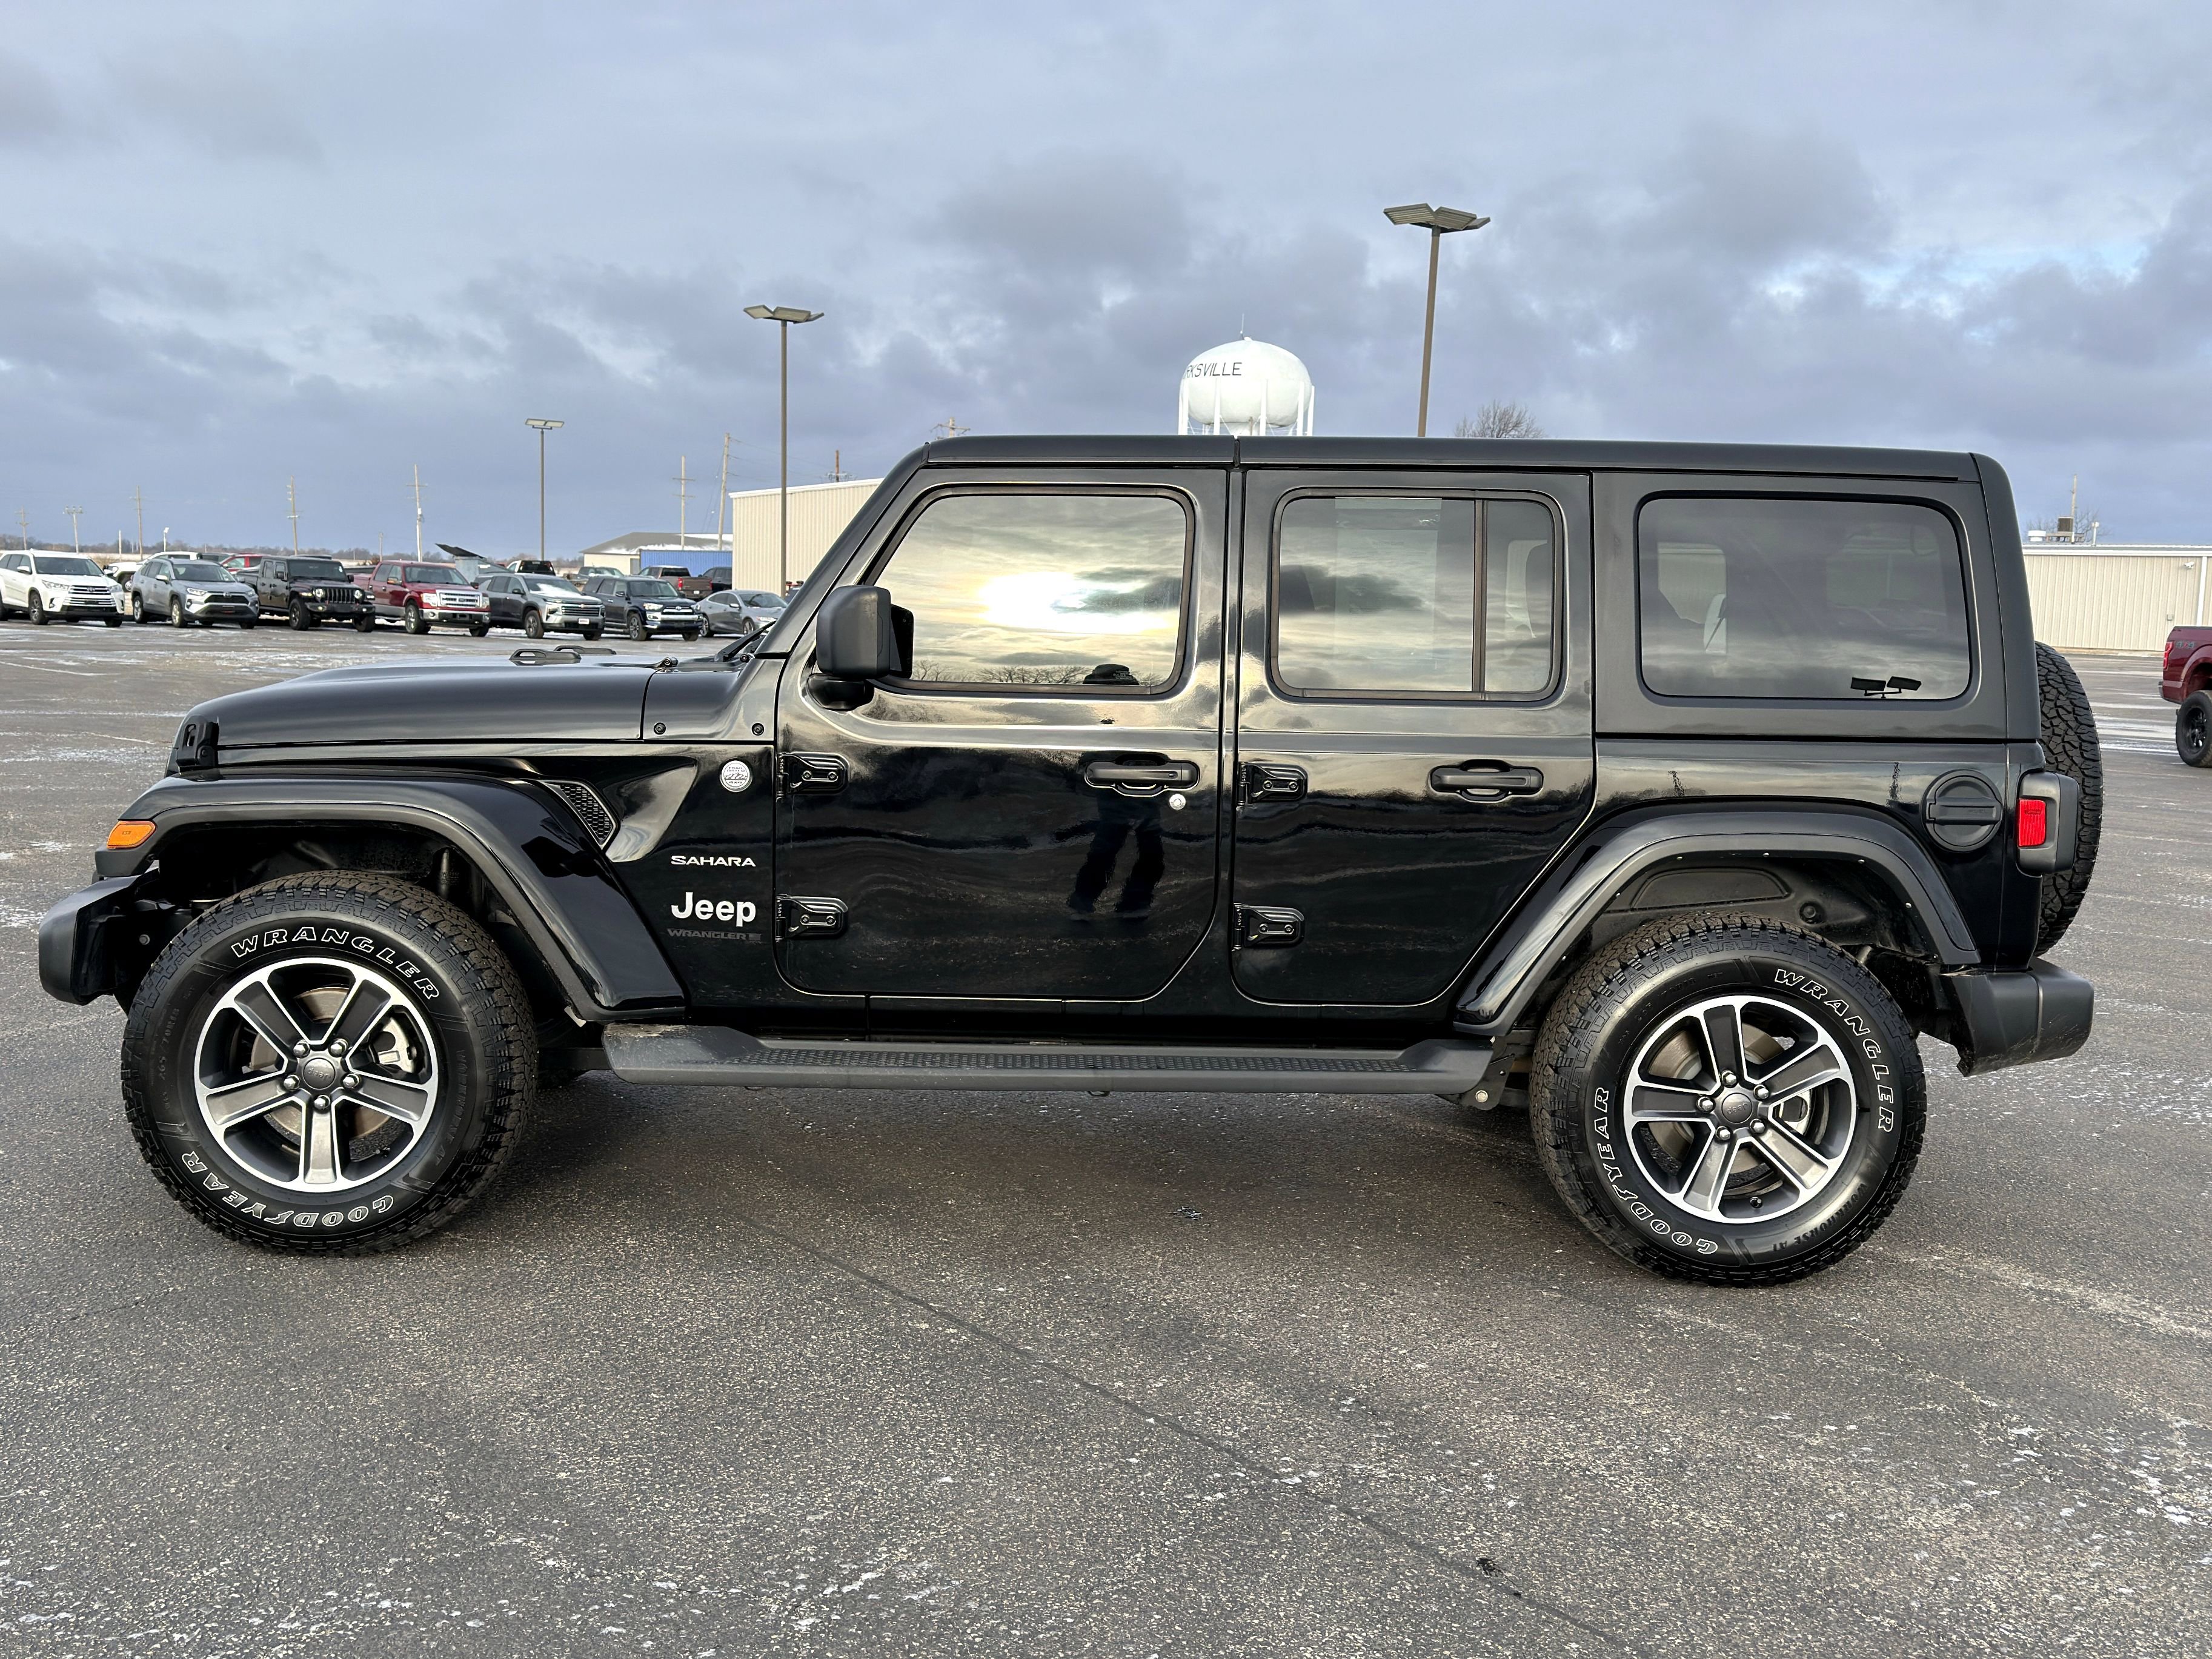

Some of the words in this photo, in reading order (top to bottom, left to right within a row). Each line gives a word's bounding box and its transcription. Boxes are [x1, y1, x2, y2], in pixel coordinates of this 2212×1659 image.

[671, 855, 756, 867] SAHARA
[667, 928, 747, 940] WRANGLER
[671, 891, 756, 927] Jeep
[230, 926, 440, 1002] WRANGLER
[1775, 968, 1895, 1134] WRANGLER
[181, 1151, 394, 1228] GOODYEAR
[1593, 1086, 1719, 1255] GOODYEAR
